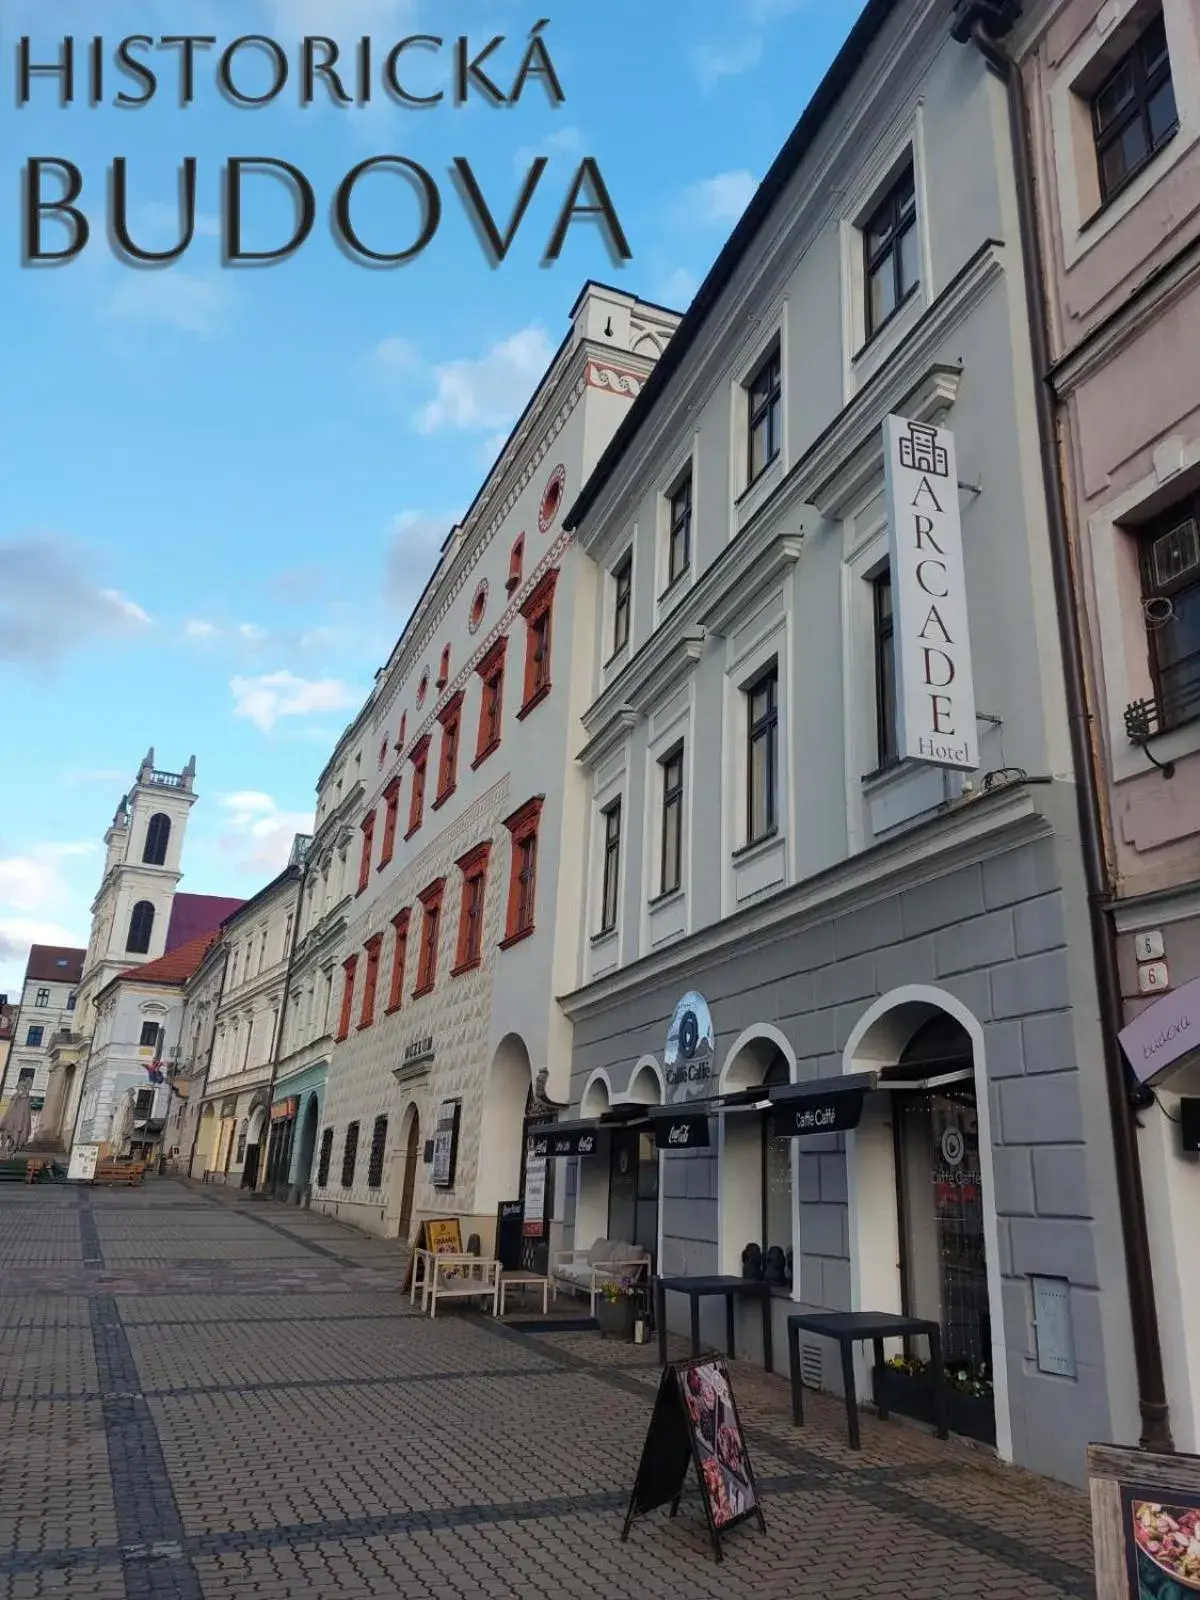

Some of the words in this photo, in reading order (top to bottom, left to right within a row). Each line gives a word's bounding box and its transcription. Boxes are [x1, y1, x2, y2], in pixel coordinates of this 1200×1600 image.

[911, 475, 956, 736] ARCADE
[919, 736, 969, 763] Hotel
[1145, 937, 1152, 954] 6
[1148, 968, 1156, 985] 6
